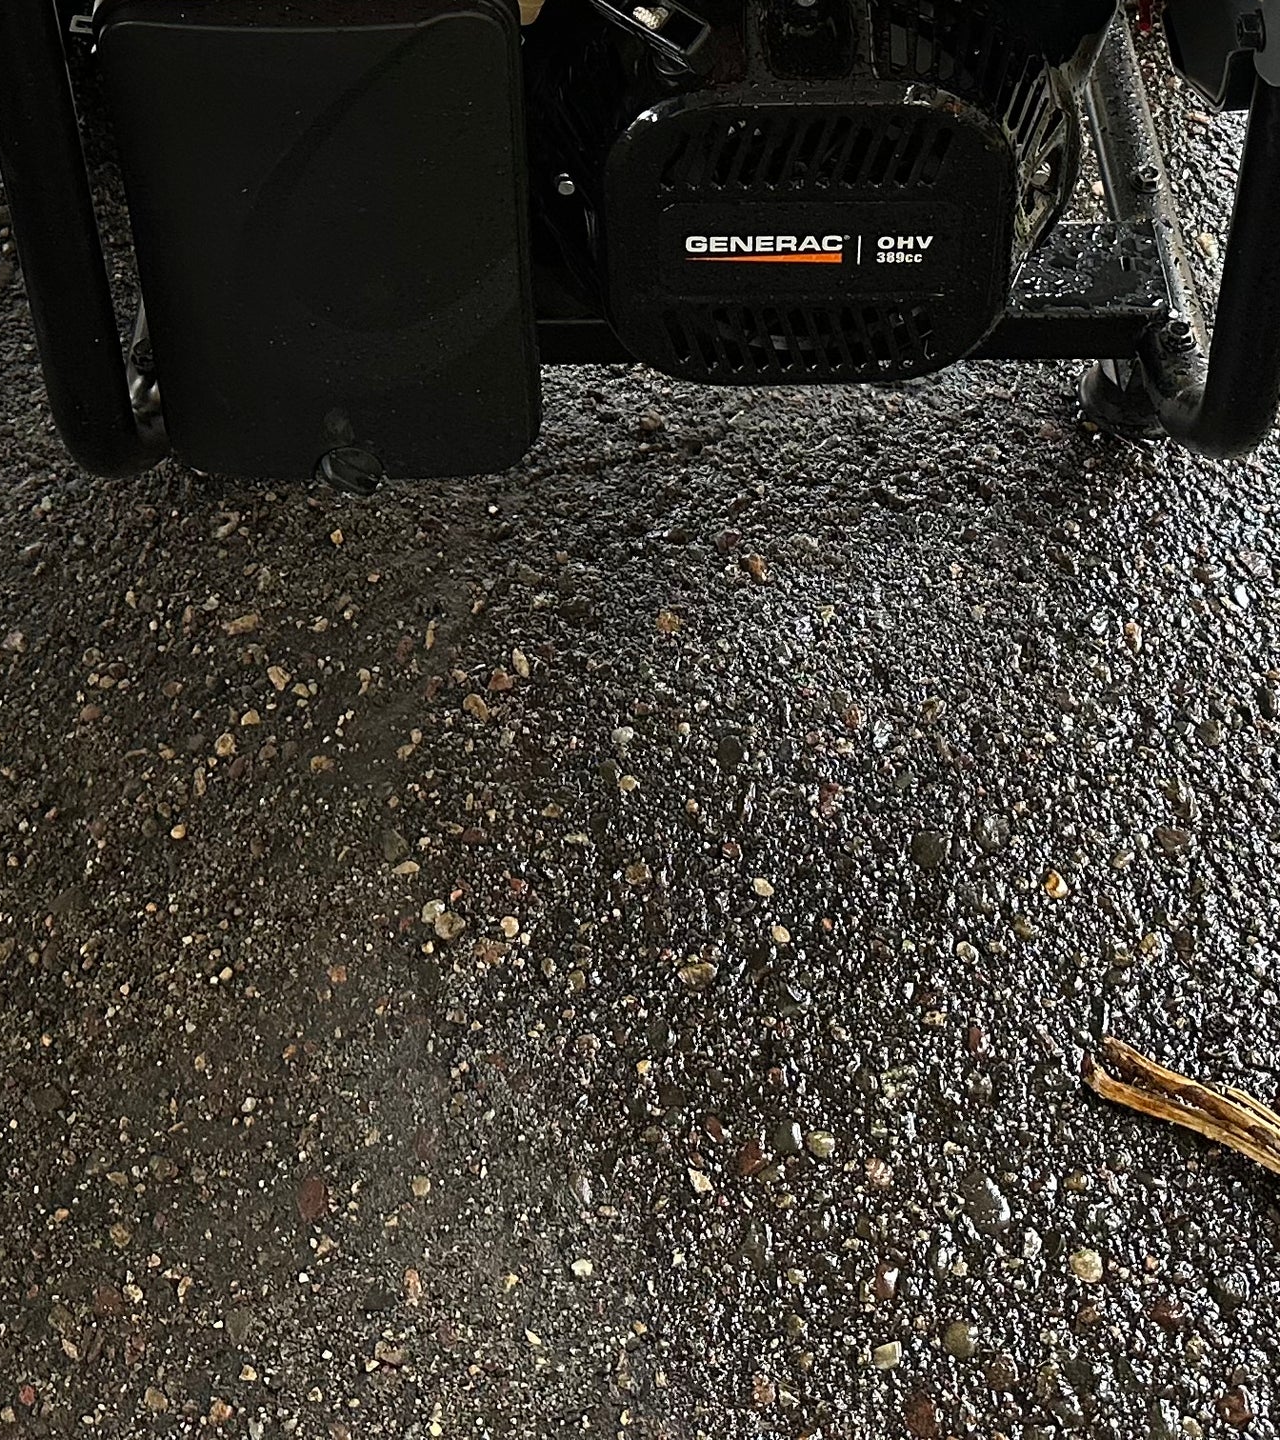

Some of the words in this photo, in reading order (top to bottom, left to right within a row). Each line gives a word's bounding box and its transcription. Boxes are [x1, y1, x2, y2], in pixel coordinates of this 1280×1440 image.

[685, 235, 843, 252] GENERAC
[877, 235, 934, 250] OHV
[876, 251, 923, 264] 389cc
